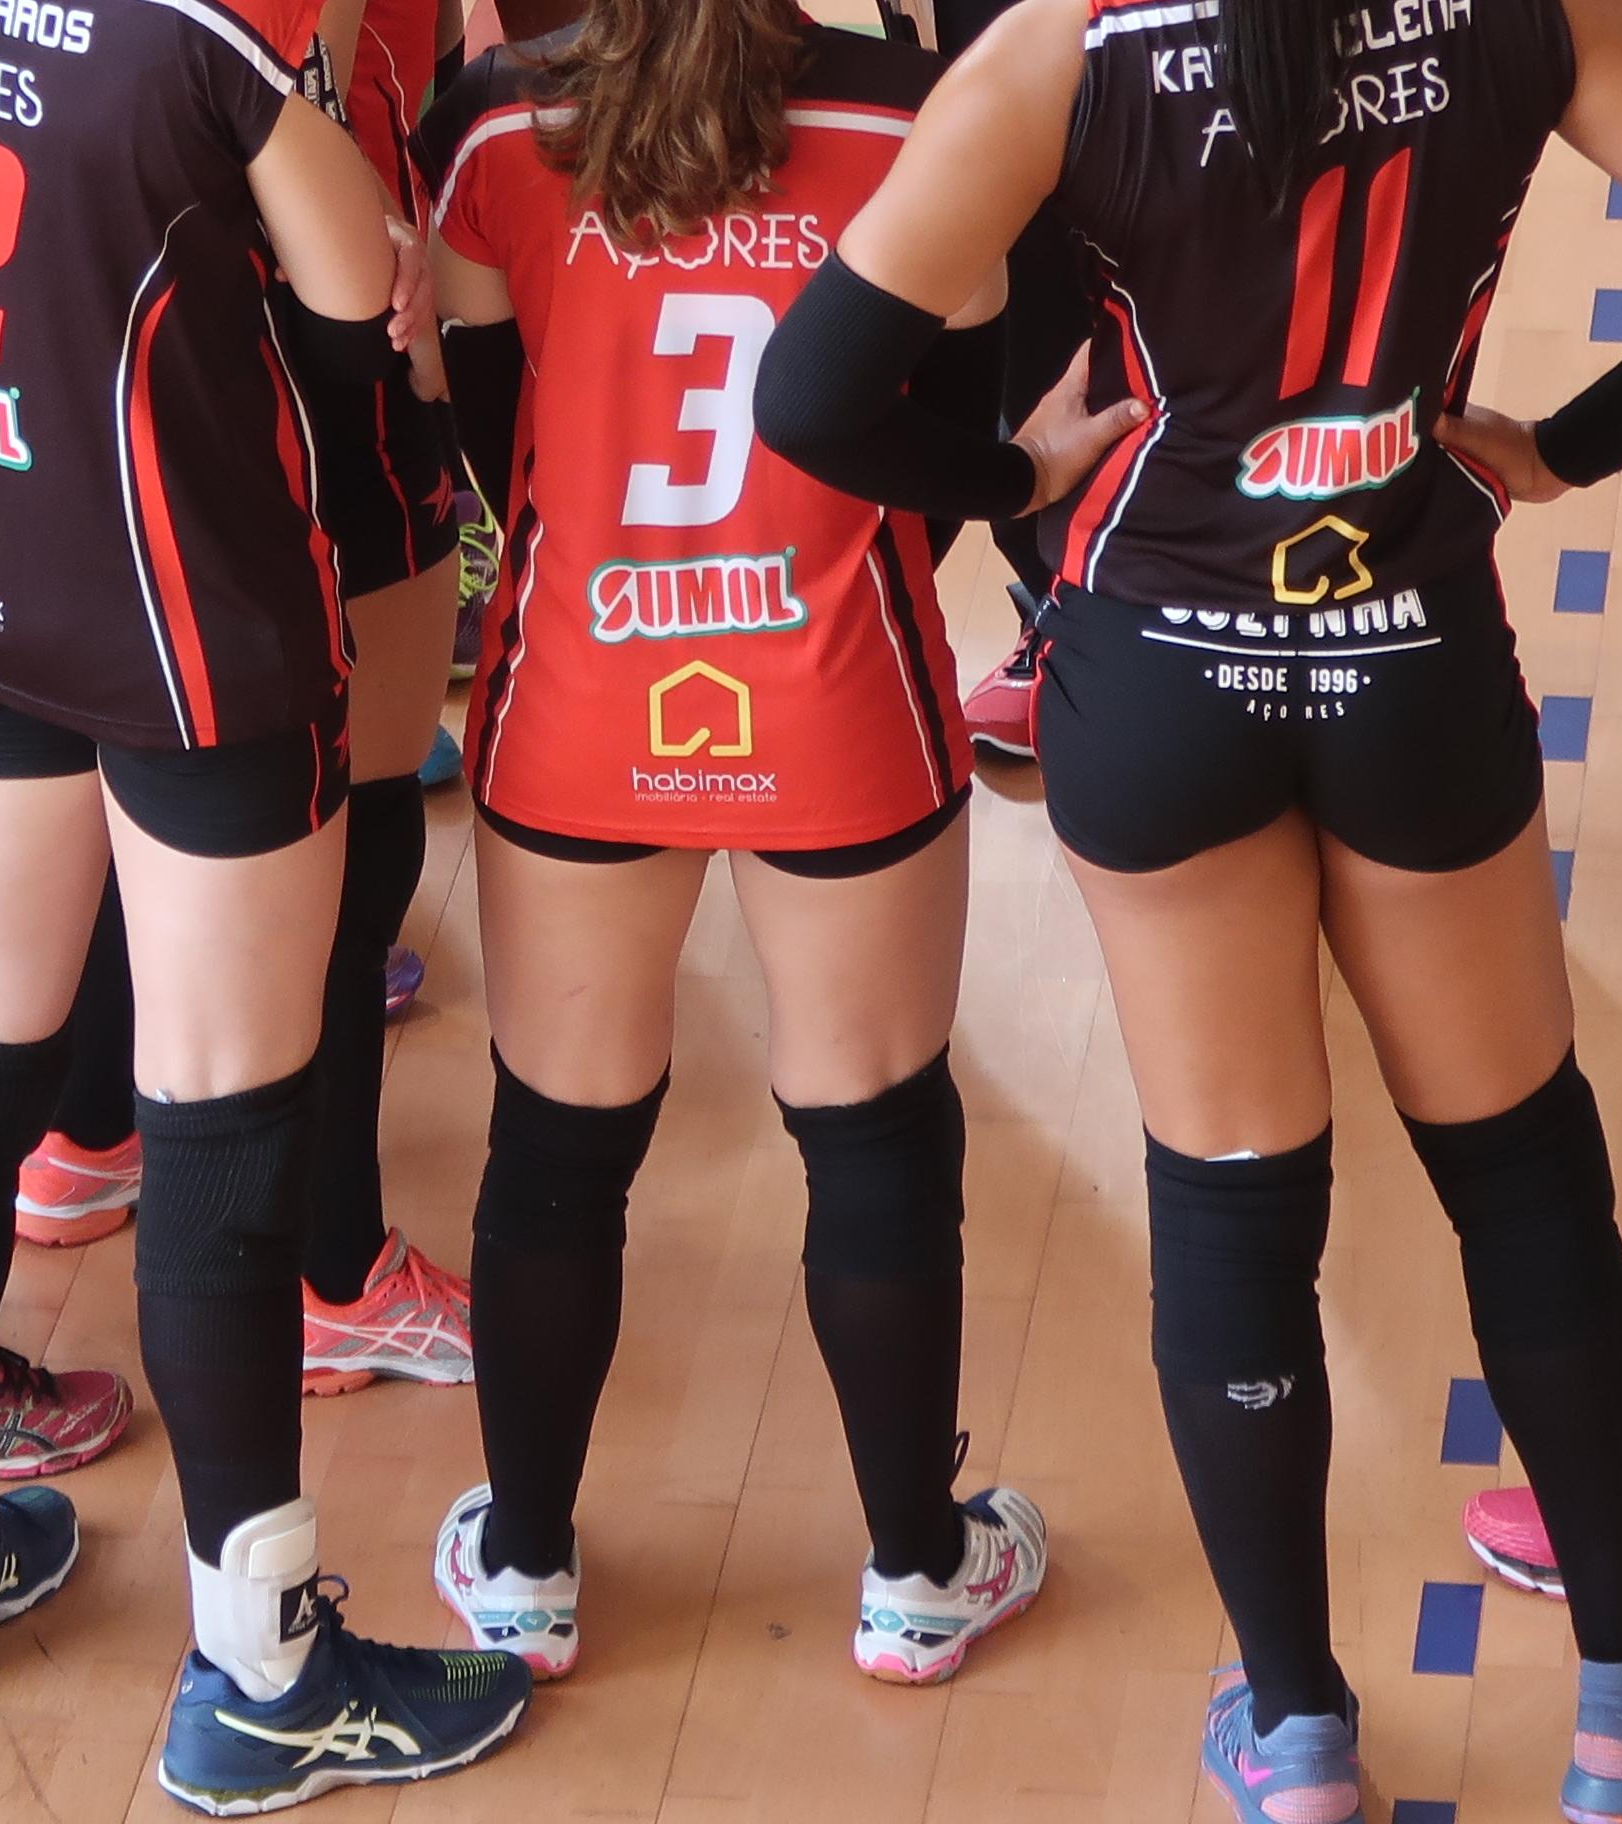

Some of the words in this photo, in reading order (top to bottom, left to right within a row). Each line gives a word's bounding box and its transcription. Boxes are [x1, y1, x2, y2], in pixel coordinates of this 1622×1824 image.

[1279, 147, 1412, 401] 11
[621, 294, 777, 528] 3
[1235, 398, 1424, 500] SUMOL
[591, 552, 806, 641] SUMOL
[1217, 663, 1288, 693] DESDE
[1309, 668, 1359, 695] 1996
[631, 766, 777, 792] habimax
[634, 791, 698, 803] imobiliária
[708, 791, 735, 803] real
[737, 792, 778, 803] estate
